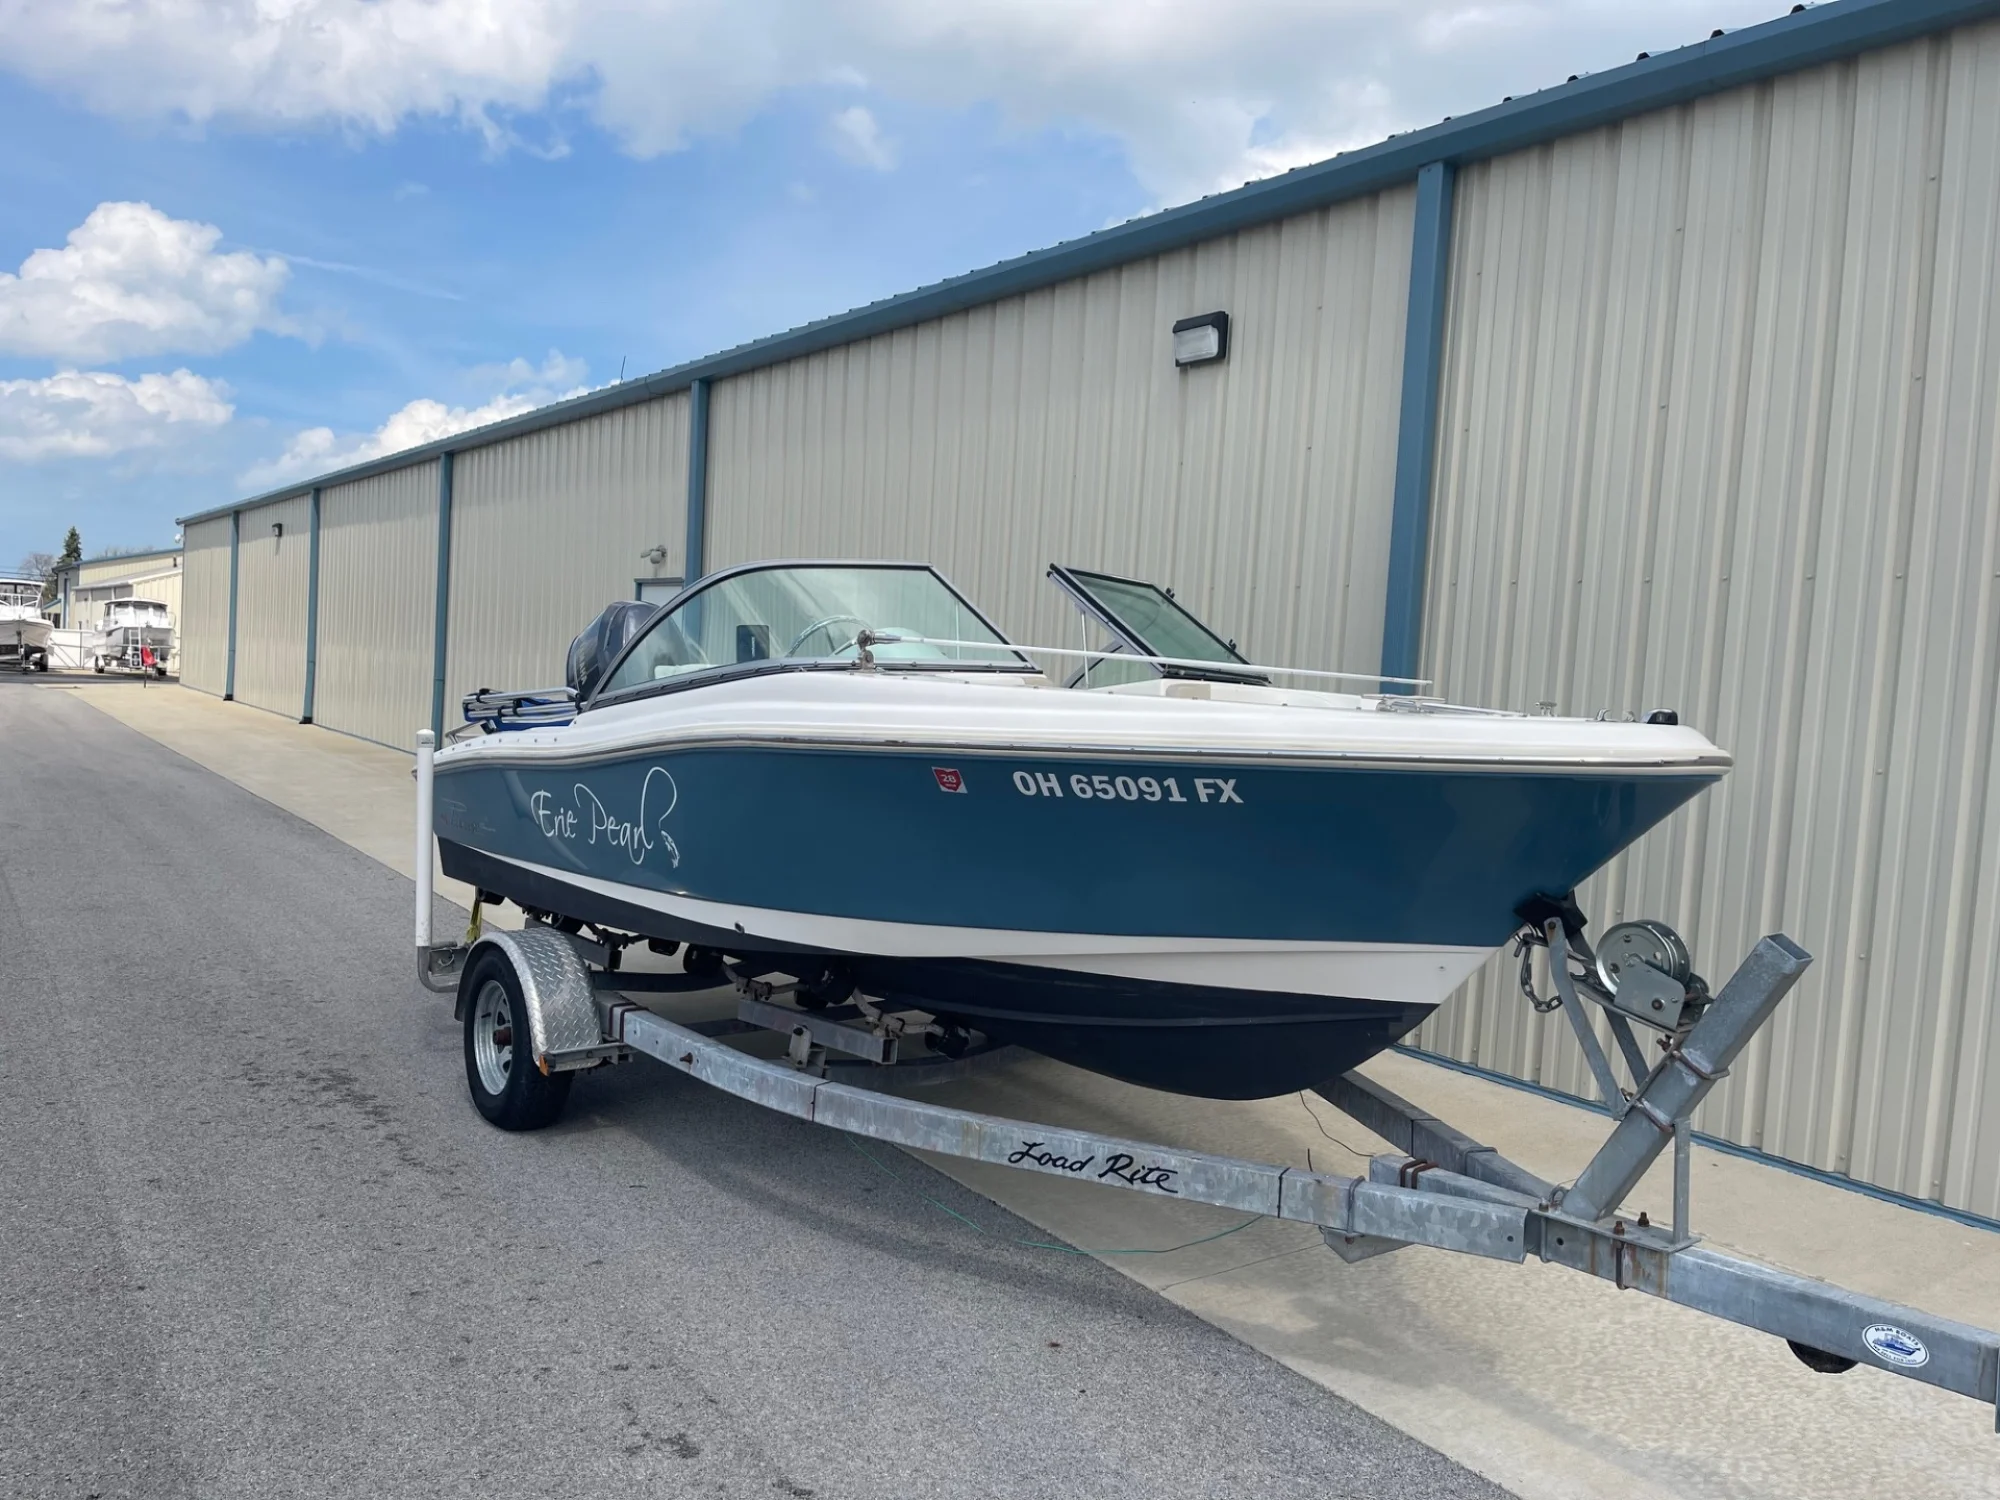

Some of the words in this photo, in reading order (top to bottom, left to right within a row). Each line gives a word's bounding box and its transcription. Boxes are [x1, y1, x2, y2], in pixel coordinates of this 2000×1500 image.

[1012, 771, 1064, 797] OH
[1069, 774, 1187, 802] 65091
[1193, 778, 1244, 804] FX
[530, 789, 578, 838] Erie
[574, 766, 678, 865] Pearl
[1007, 1141, 1095, 1172] Load
[1097, 1153, 1179, 1194] Rite
[1895, 1329, 1919, 1346] BOATS
